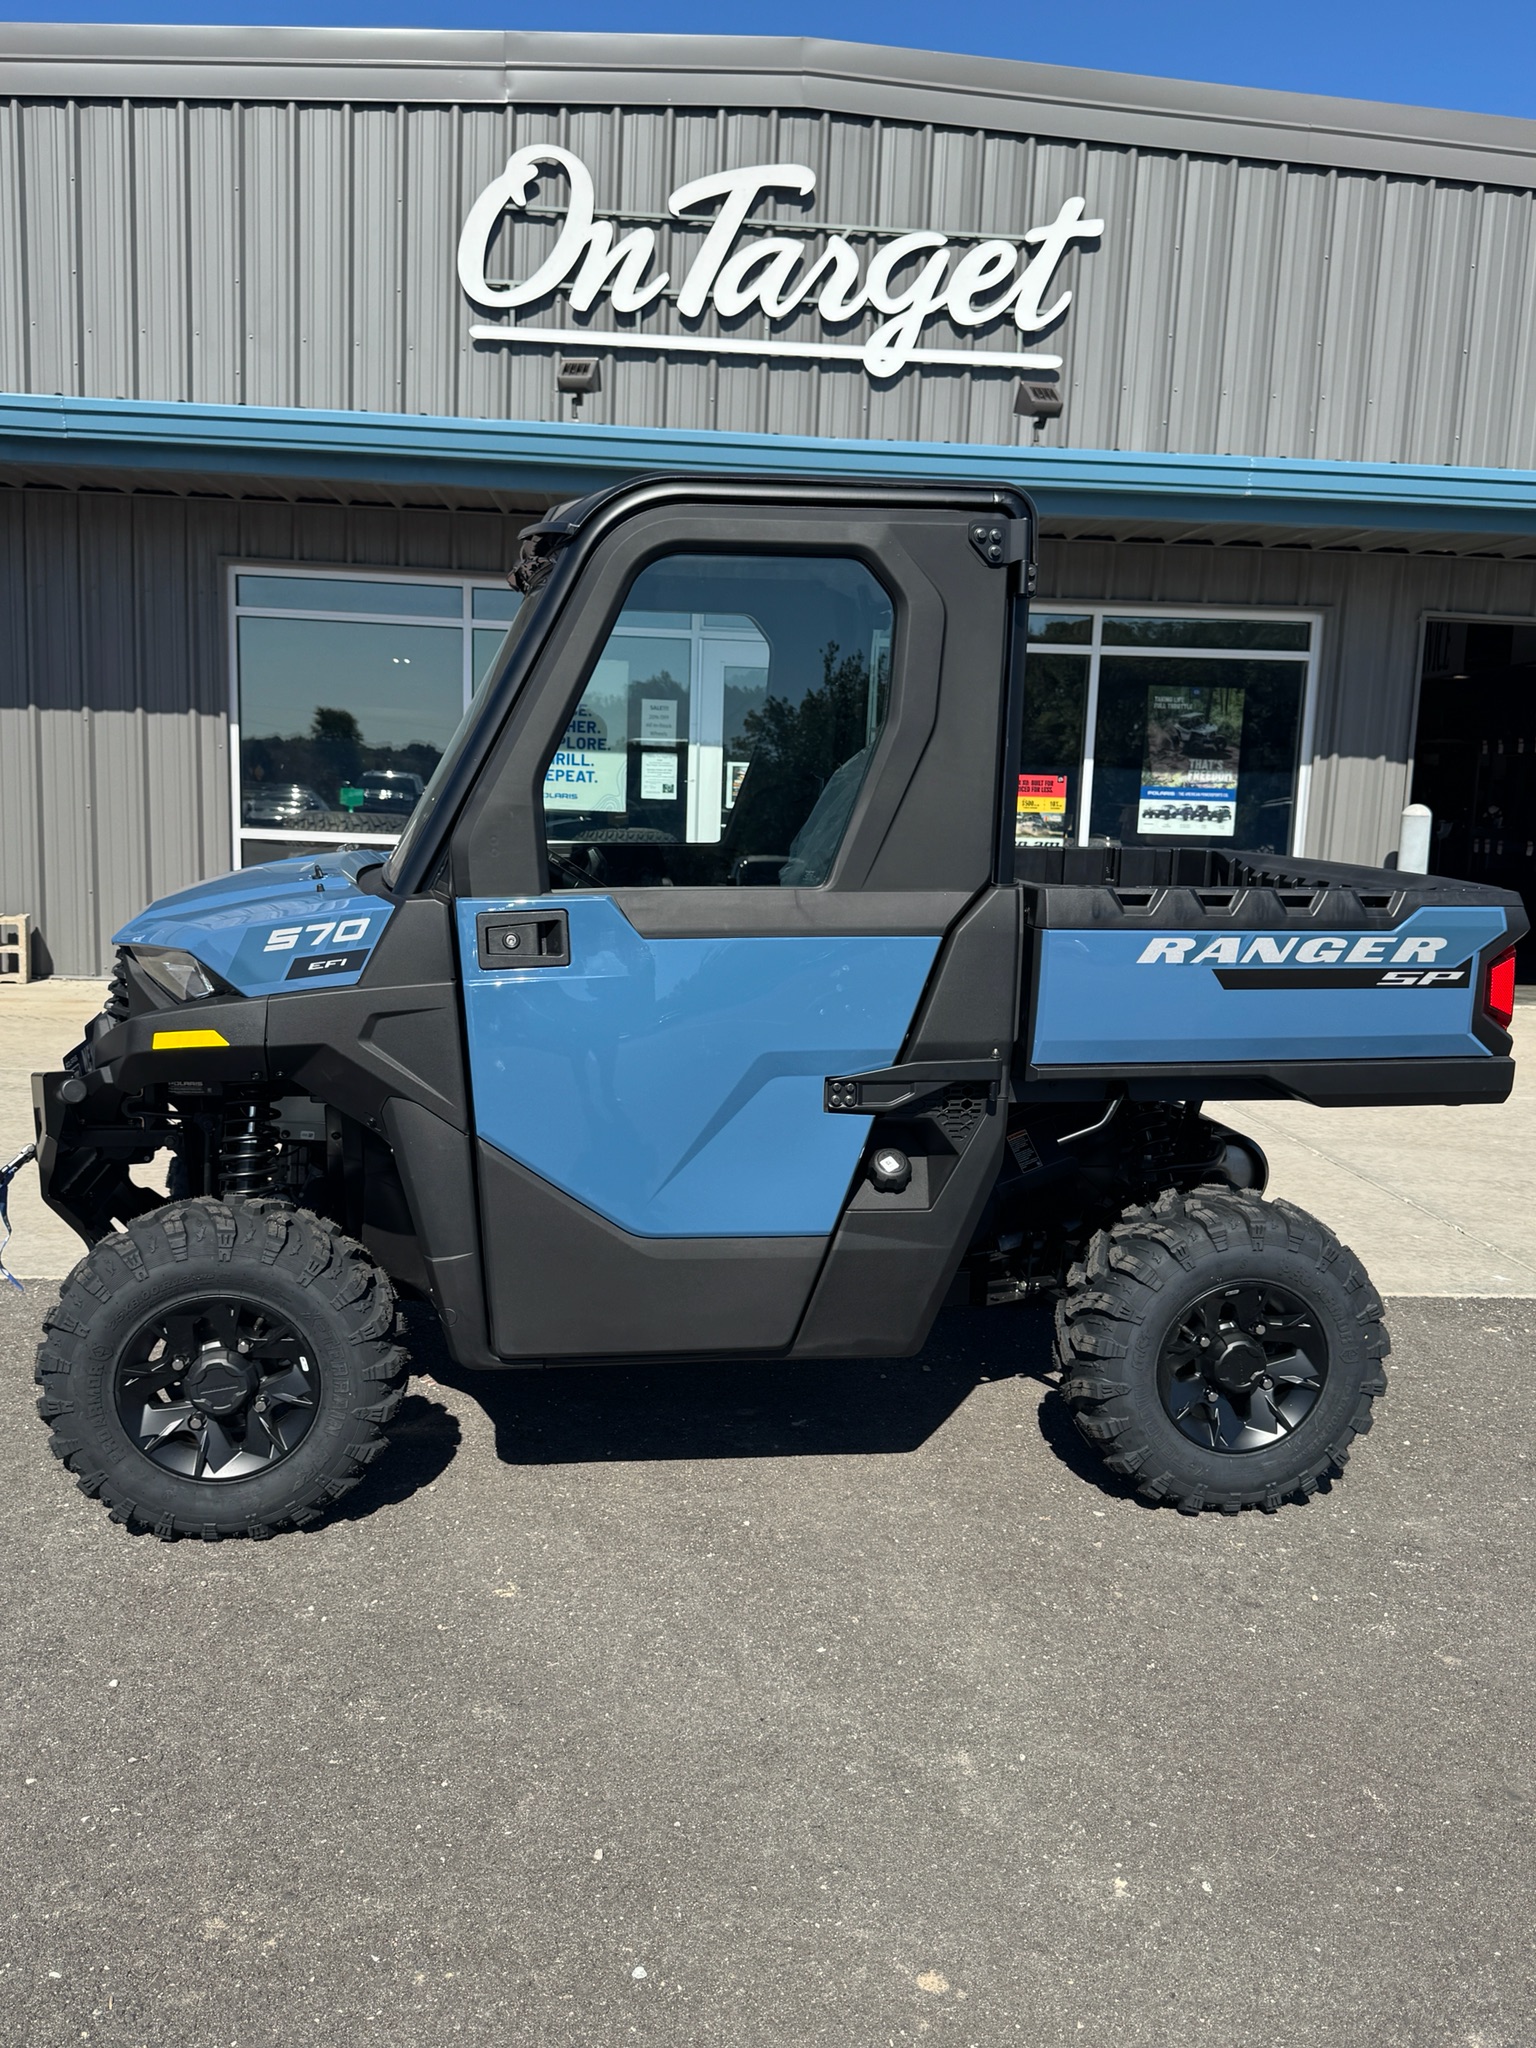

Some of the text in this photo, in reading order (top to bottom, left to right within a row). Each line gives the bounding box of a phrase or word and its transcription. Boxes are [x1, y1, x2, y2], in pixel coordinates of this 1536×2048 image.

[552, 753, 595, 767] RILL.
[1189, 759, 1224, 770] THAT'S
[263, 917, 371, 952] 570
[1136, 937, 1447, 964] RANGER
[308, 958, 348, 971] EFI
[1376, 971, 1465, 985] SP
